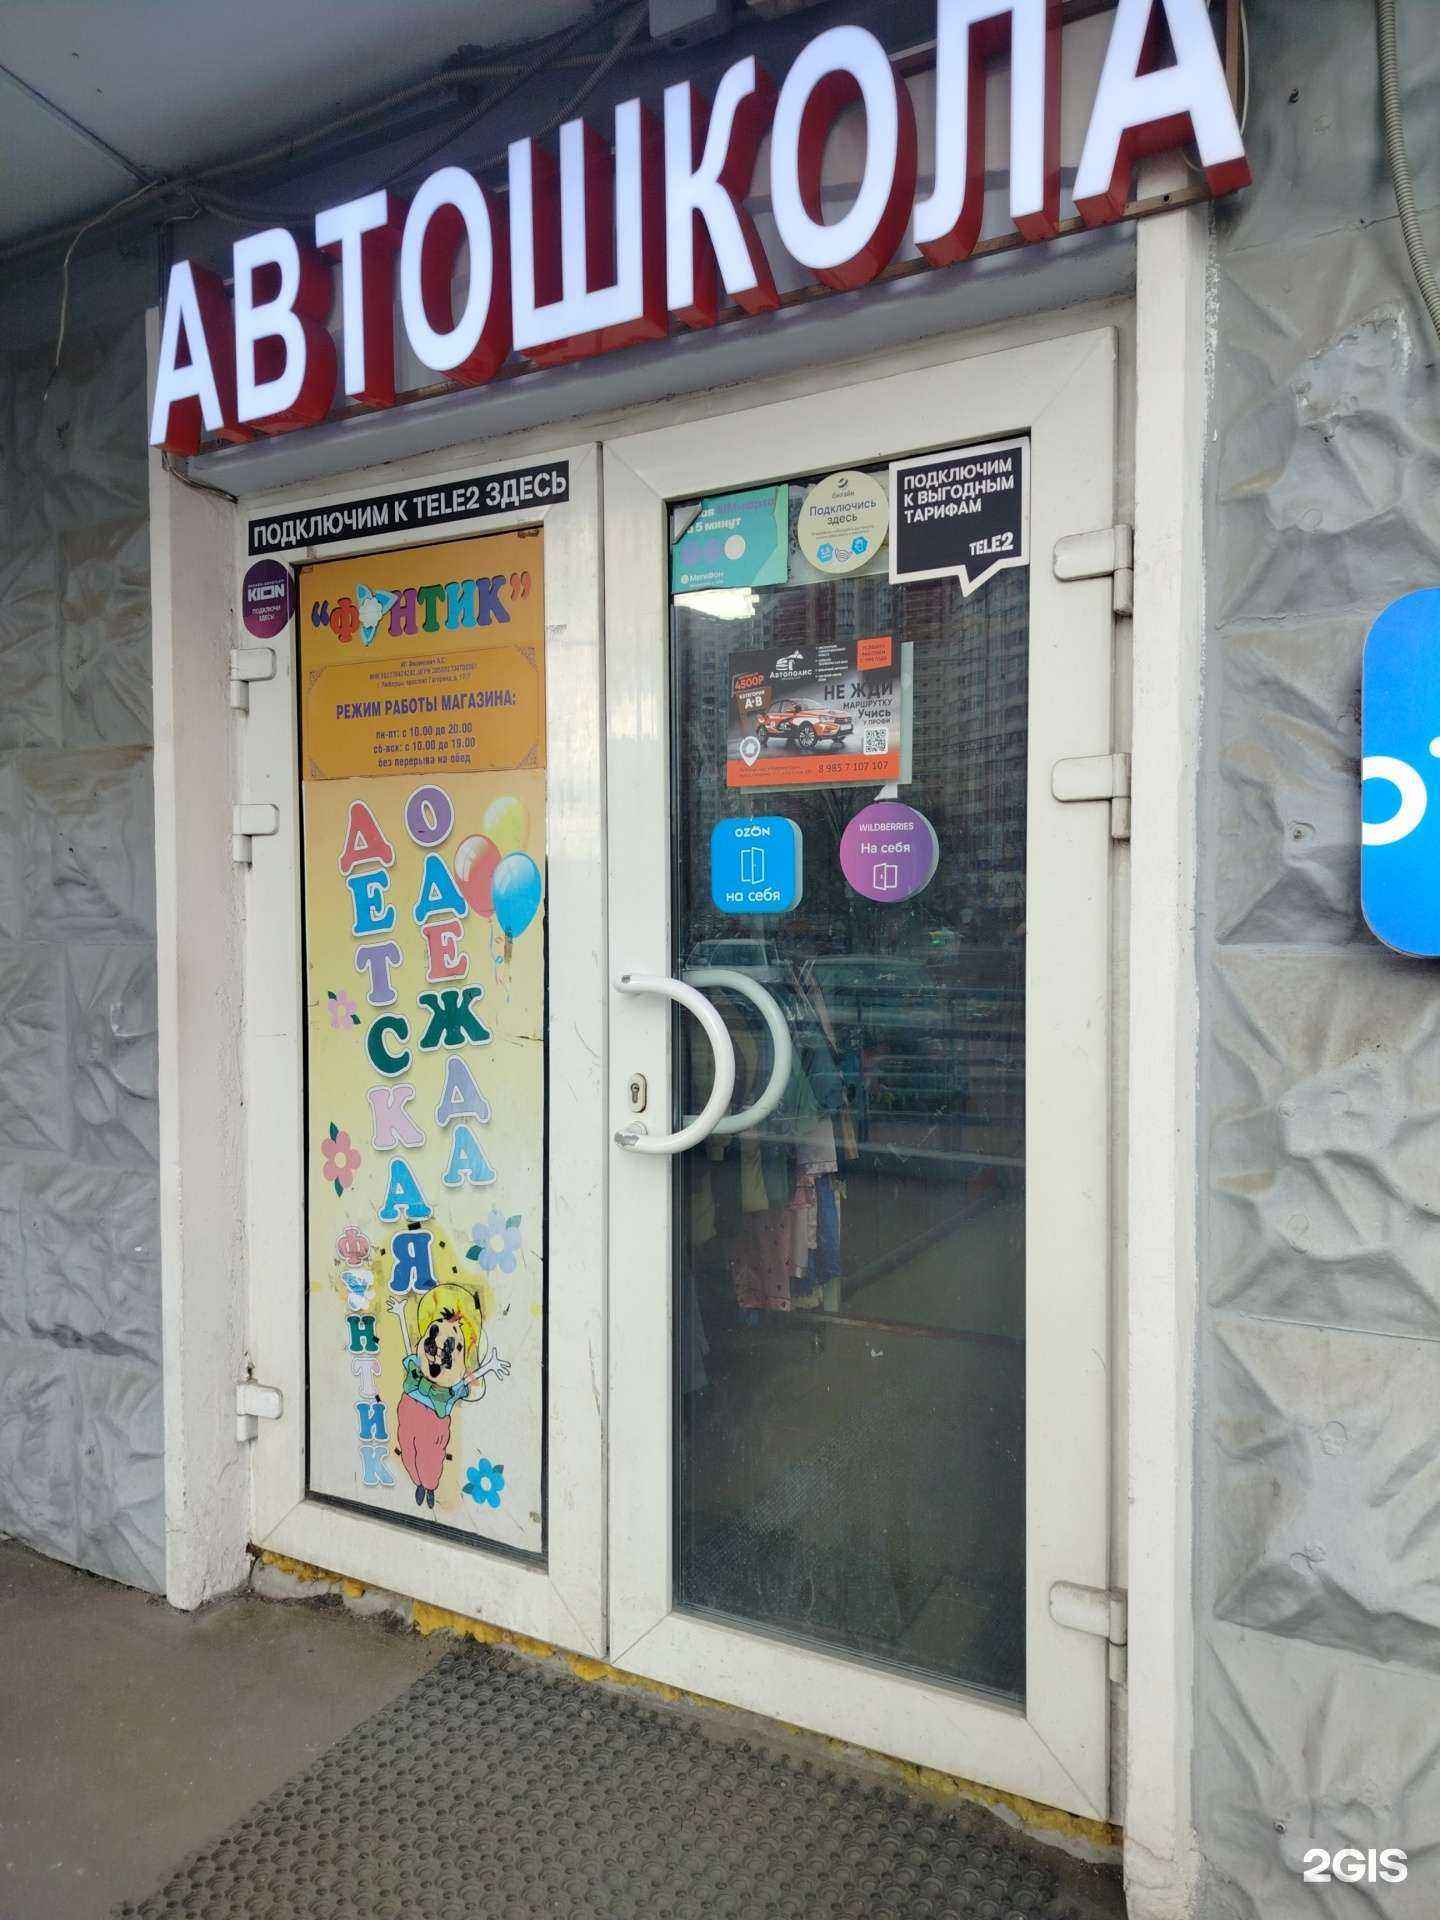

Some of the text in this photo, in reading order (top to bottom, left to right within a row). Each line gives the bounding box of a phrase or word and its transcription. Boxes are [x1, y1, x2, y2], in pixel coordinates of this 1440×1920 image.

[150, 0, 1245, 447] АВТОШКОЛА
[904, 457, 1012, 490] ПОДКЛЮЧИМ
[903, 475, 1014, 507] К ВЫГОДНЫМ
[253, 470, 567, 548] ПОДКЛЮЧИМ К TELE2 ЗДЕСЬ
[809, 499, 877, 516] Подключись
[904, 498, 982, 524] ТАРИФАМ
[827, 513, 858, 526] здесь
[969, 531, 1014, 556] TELE2
[247, 583, 285, 602] KION
[824, 680, 893, 701] НЕ ЖДИ
[336, 689, 516, 720] РЕЖИМ РАБОТЫ МАГАЗИНА:
[842, 698, 893, 710] МАРШРУТКУ
[394, 755, 435, 768] перерыва
[818, 764, 823, 774] 8
[826, 762, 842, 773] 985
[853, 761, 869, 772] 107
[872, 760, 889, 770] 107
[859, 822, 914, 832] WILDBERRIES
[860, 841, 911, 854] На себя
[726, 887, 781, 902] на себя
